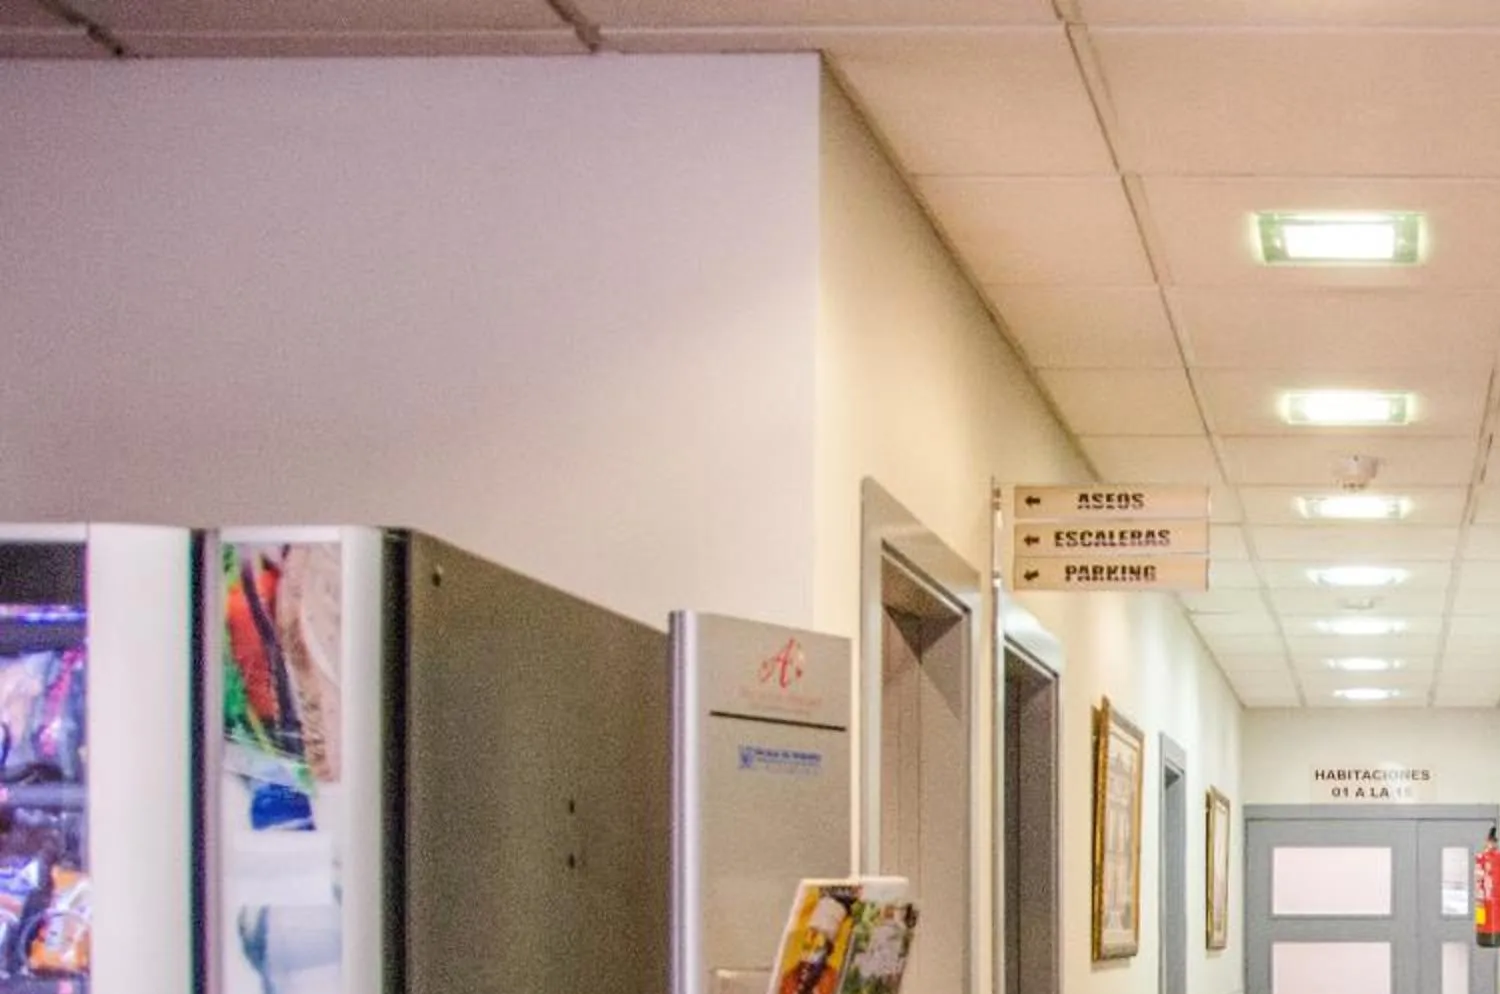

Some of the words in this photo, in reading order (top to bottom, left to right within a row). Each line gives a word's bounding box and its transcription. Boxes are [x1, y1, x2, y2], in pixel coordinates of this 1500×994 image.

[1077, 492, 1145, 510] ASEOS
[1054, 529, 1171, 548] ESCALERAS
[1064, 564, 1157, 583] PARKING
[1314, 769, 1430, 781] HABITACIONES
[1331, 787, 1349, 798] 01
[1355, 787, 1365, 798] A
[1369, 787, 1390, 798] LA
